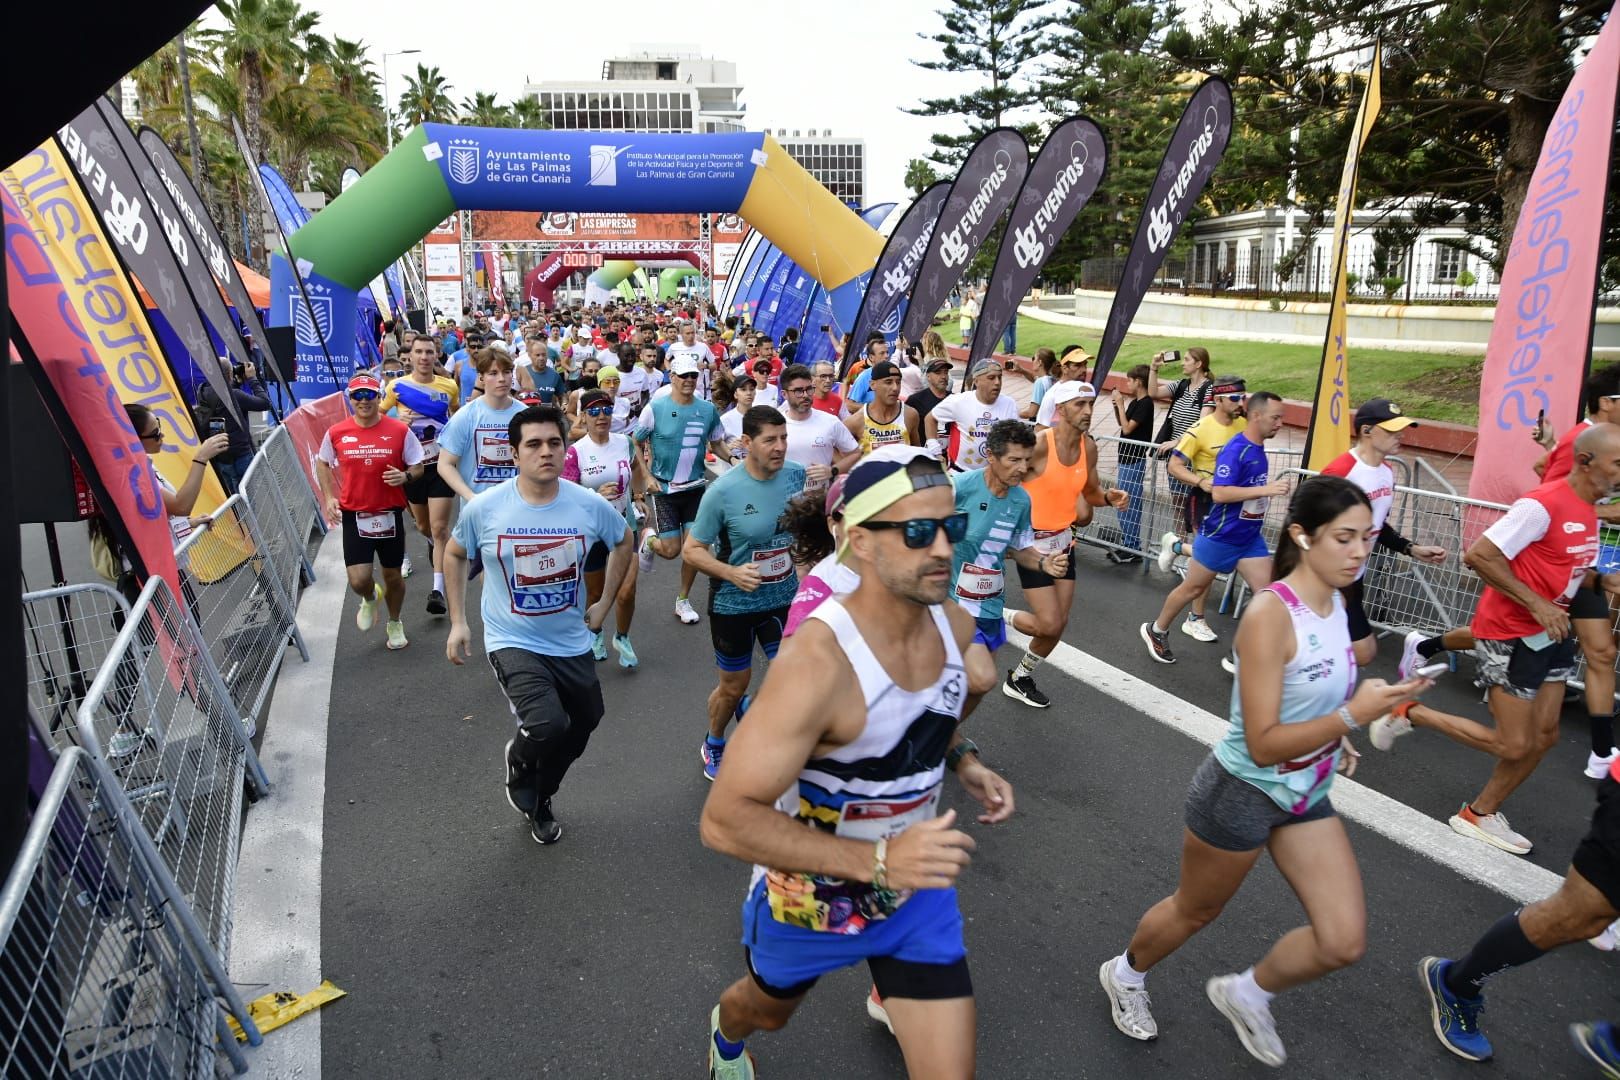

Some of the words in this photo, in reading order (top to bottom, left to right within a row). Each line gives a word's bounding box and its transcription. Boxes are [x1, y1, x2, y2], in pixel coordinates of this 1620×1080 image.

[486, 149, 571, 161] Ayuntamiento
[626, 152, 652, 160] Instituto
[654, 152, 686, 161] Municipal
[486, 161, 501, 171] de
[507, 161, 525, 171] Las
[531, 162, 571, 172] Palmas
[627, 160, 637, 168] de
[637, 160, 644, 168] la
[645, 160, 675, 168] Actividad
[700, 160, 707, 168] el
[708, 161, 734, 170] Deporte
[486, 172, 501, 182] de
[502, 173, 528, 183] Gran
[531, 173, 571, 184] Canaria
[636, 170, 648, 178] Las
[649, 170, 675, 179] Palmas
[676, 170, 687, 179] de
[688, 171, 705, 179] Gran
[707, 171, 735, 179] Canaria
[1146, 202, 1173, 255] dg
[1168, 124, 1214, 209] EVENTOS
[938, 221, 970, 270] dg
[960, 163, 1007, 236] EVENTOS
[1012, 220, 1046, 270] dg
[1034, 156, 1085, 235] EVENTOS
[580, 219, 595, 229] LAS
[596, 219, 636, 229] EMPRESAS
[297, 364, 310, 372] as
[481, 468, 516, 478] ALDI
[506, 527, 528, 535] ALDI
[530, 527, 578, 535] CANARIAS
[538, 557, 555, 571] 278
[522, 593, 571, 609] ALDI
